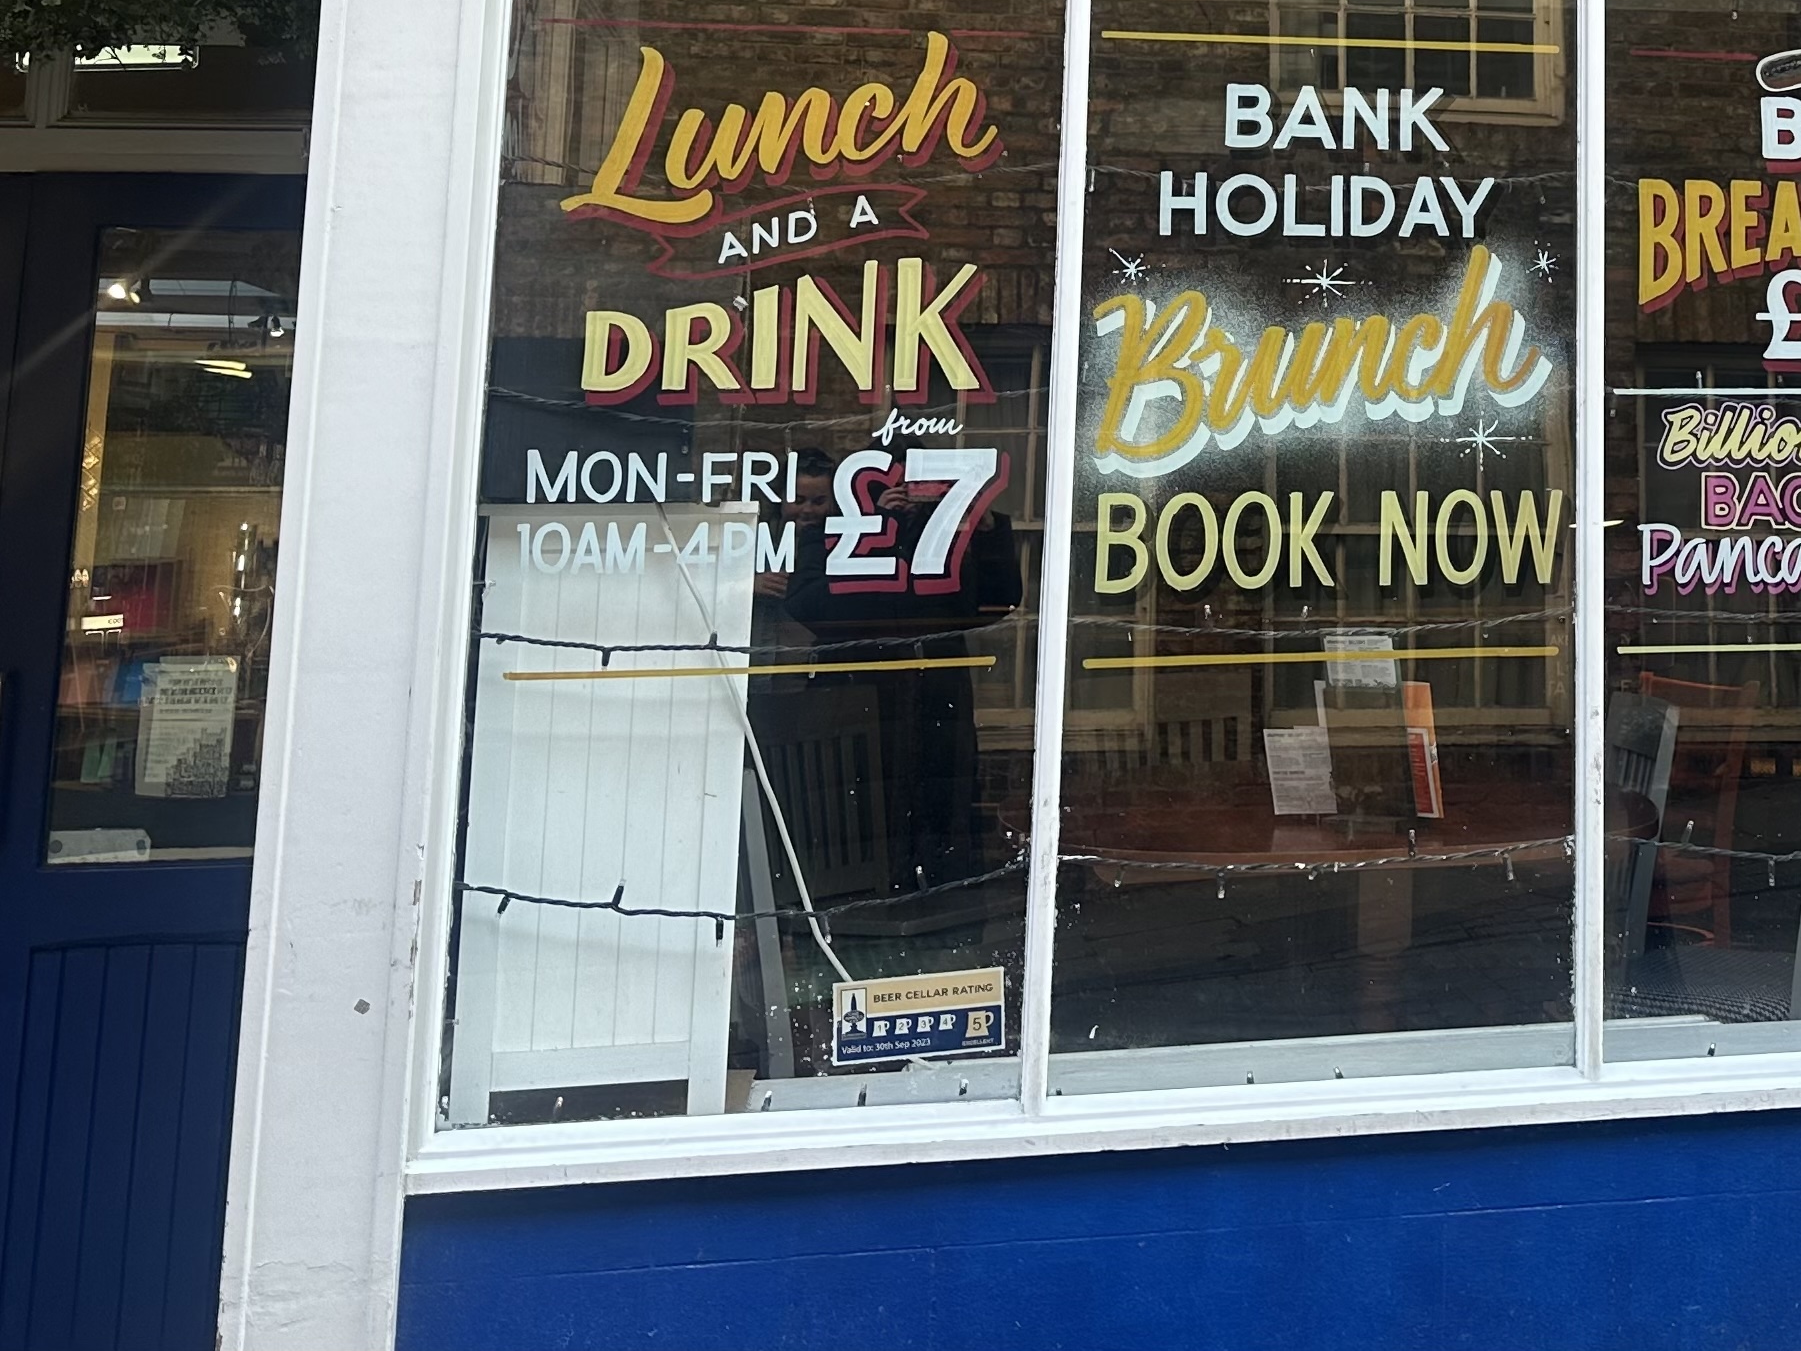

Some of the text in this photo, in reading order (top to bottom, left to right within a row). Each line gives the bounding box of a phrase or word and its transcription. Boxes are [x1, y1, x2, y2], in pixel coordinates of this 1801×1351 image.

[560, 31, 1000, 226] Lunch
[1224, 82, 1450, 152] BANK
[717, 195, 879, 265] AND A
[1157, 170, 1495, 239] HOLIDAY
[581, 257, 990, 399] DRINK
[1094, 244, 1547, 469] Brunch
[872, 407, 964, 445] from
[526, 448, 797, 505] MON-FRI
[516, 521, 796, 575] 10AM-4PM
[824, 448, 1003, 581] £7
[1094, 488, 1563, 594] BOOK NOW
[873, 982, 994, 1003] BEER CELLAR RATING
[972, 1016, 982, 1032] 5
[894, 1040, 910, 1050] Sep
